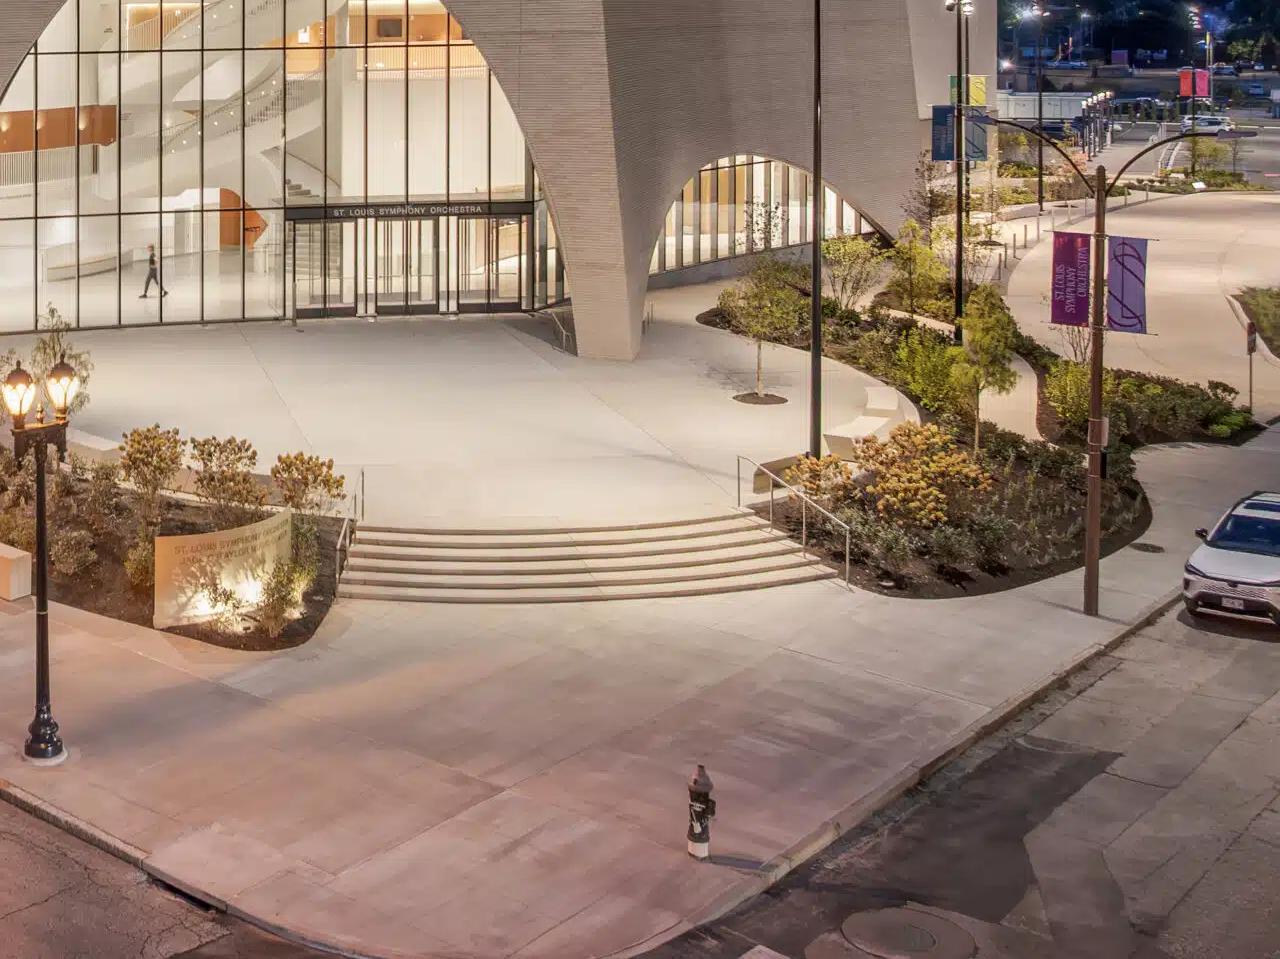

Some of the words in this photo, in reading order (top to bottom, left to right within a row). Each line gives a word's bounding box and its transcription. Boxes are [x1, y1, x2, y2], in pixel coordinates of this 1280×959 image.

[333, 208, 346, 217] ST.
[349, 208, 375, 216] LOUIS
[379, 206, 426, 215] SYMPHONY
[430, 205, 482, 214] ORCHESTRA
[1055, 264, 1065, 288] LOUIS
[1065, 266, 1076, 314] SYMPHONY
[1077, 247, 1088, 298] ORCHESTRA
